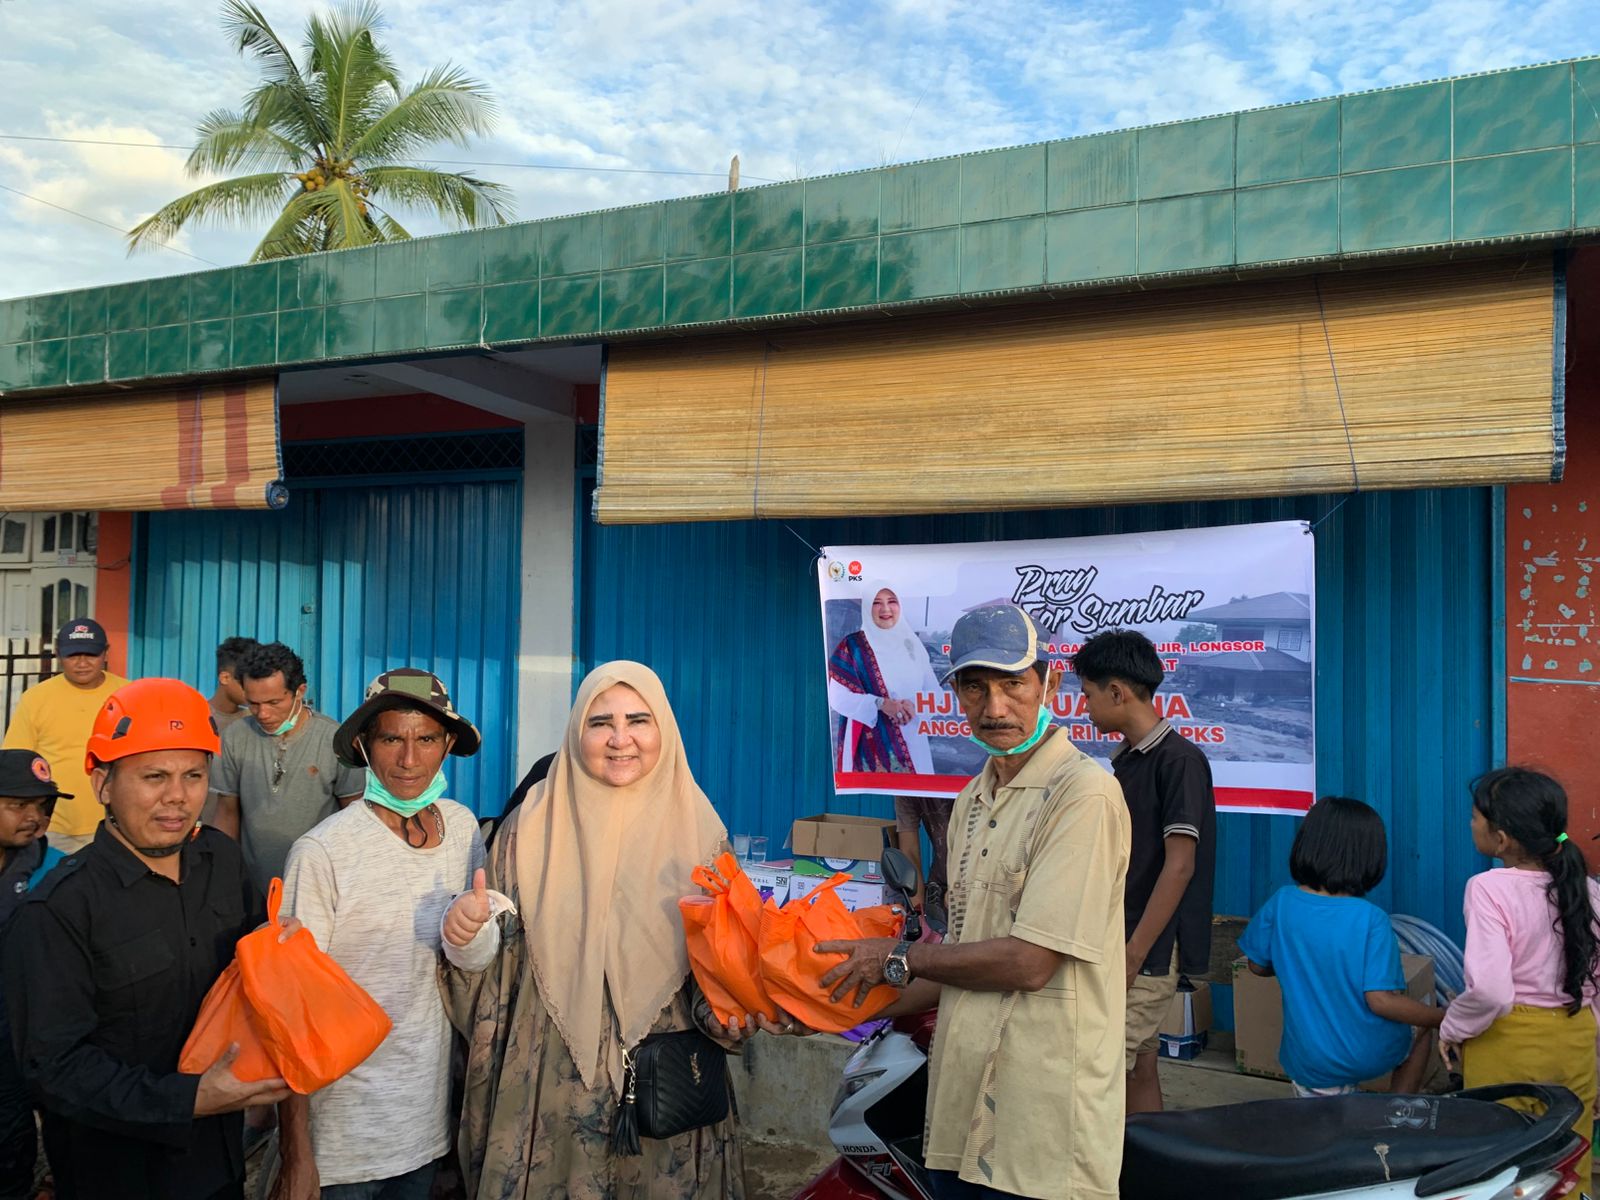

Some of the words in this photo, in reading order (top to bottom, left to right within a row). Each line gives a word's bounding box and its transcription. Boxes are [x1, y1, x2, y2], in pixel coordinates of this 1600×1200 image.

[1012, 565, 1098, 606] Pray
[1072, 585, 1204, 634] Sumbar
[1190, 641, 1266, 653] LONGSOR
[916, 692, 952, 715] HJ
[917, 720, 972, 737] ANGG
[1179, 726, 1226, 743] PKS
[842, 1145, 878, 1153] HONDA
